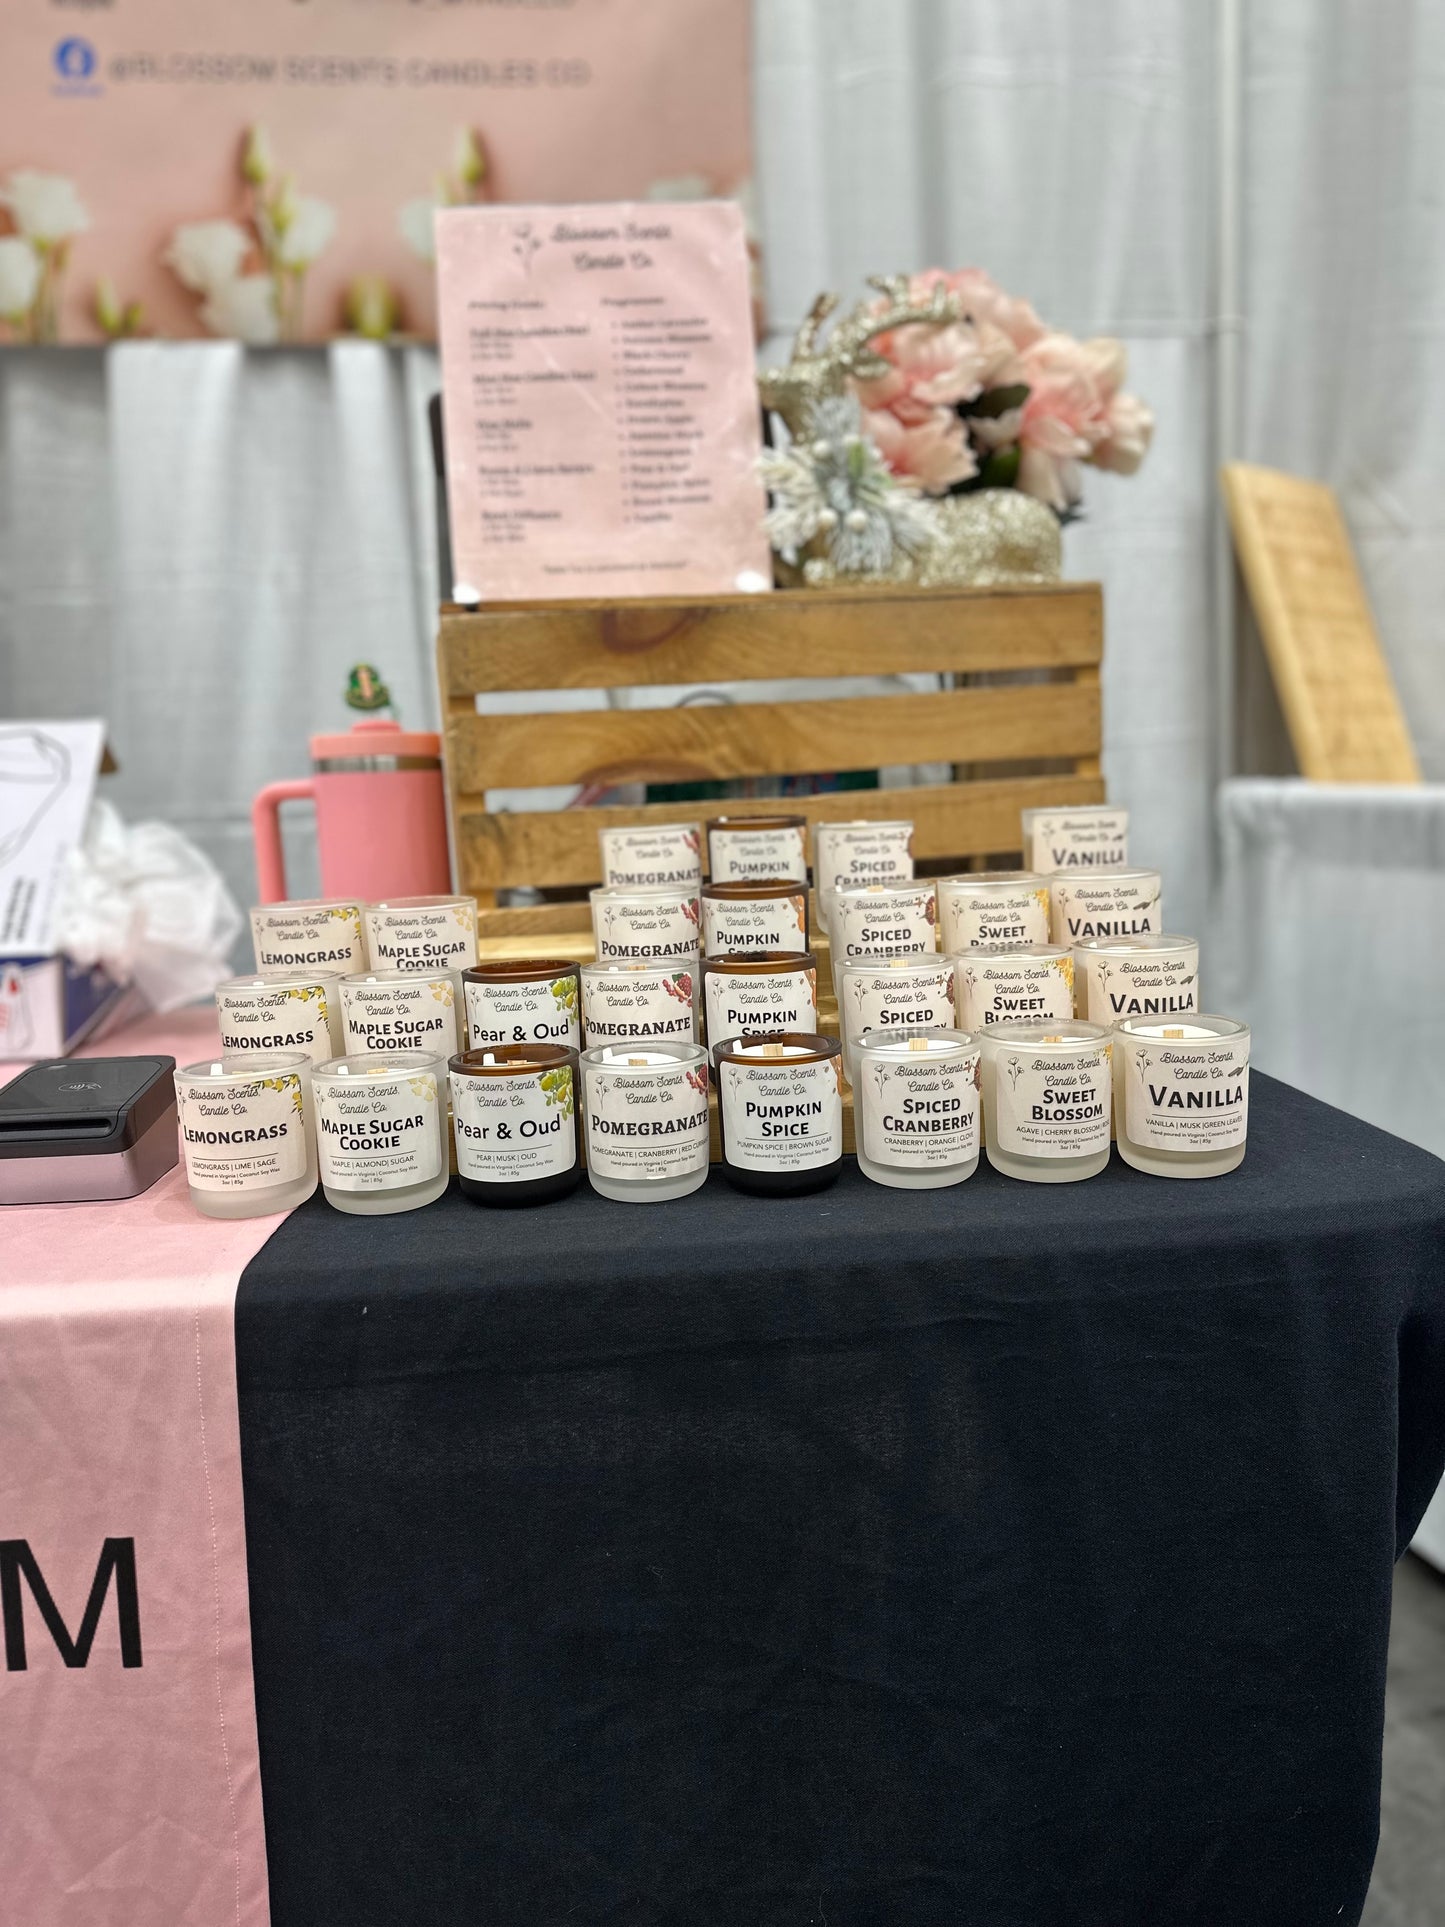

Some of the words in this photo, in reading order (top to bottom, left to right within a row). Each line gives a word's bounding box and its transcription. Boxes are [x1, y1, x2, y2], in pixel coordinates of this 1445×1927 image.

[1052, 848, 1124, 866] VANILLA
[730, 861, 789, 873] PUMPKIN
[850, 860, 896, 873] SPICED
[979, 926, 1026, 938] SWEET
[1068, 918, 1151, 937] VANILLA
[717, 931, 780, 945] PUMPKIN
[862, 929, 912, 941] SPICED
[378, 945, 419, 958] MAPLE
[423, 941, 466, 956] SUGAR
[261, 947, 352, 965] LEMONGRASS
[1120, 963, 1160, 973] Blossom
[983, 970, 1021, 979] Blossom
[597, 982, 630, 992] Blossom
[728, 980, 765, 989] Blossom
[872, 980, 910, 990] Blossom
[1132, 977, 1162, 987] Candle
[483, 988, 519, 998] Blossom
[995, 984, 1024, 994] Candle
[355, 991, 391, 1001] Blossom
[606, 996, 633, 1006] Candle
[739, 994, 768, 1004] Candle
[884, 994, 913, 1004] Candle
[224, 998, 255, 1008] Blossom
[494, 1002, 522, 1012] Candle
[994, 997, 1045, 1010] SWEET
[1110, 993, 1193, 1013] VANILLA
[366, 1005, 394, 1016] Candle
[233, 1012, 259, 1022] Candle
[728, 1010, 797, 1024] PUMPKIN
[880, 1010, 933, 1024] SPICED
[349, 1020, 391, 1035] MAPLE
[394, 1018, 443, 1034] SUGAR
[474, 1024, 506, 1041] Pear
[513, 1026, 527, 1041] &
[534, 1018, 569, 1039] Oud
[586, 1017, 691, 1036] POMEGRANATE
[222, 1031, 313, 1049] LEMONGRASS
[367, 1036, 422, 1049] COOKIE
[1160, 1053, 1205, 1063] Blossom
[1032, 1060, 1075, 1070] Blossom
[746, 1070, 787, 1080] Blossom
[895, 1066, 937, 1076] Blossom
[1174, 1068, 1208, 1079] Candle
[466, 1081, 504, 1091] Blossom
[613, 1078, 654, 1088] Blossom
[1045, 1075, 1077, 1086] Candle
[759, 1085, 790, 1096] Candle
[908, 1081, 939, 1092] Candle
[188, 1089, 225, 1100] Blossom
[328, 1087, 365, 1098] Blossom
[1043, 1088, 1096, 1104] SWEET
[1149, 1084, 1243, 1108] VANILLA
[477, 1096, 507, 1107] Candle
[626, 1093, 657, 1104] Candle
[199, 1105, 229, 1116] Candle
[338, 1103, 369, 1114] Candle
[746, 1101, 821, 1118] PUMPKIN
[903, 1098, 960, 1114] SPICED
[1032, 1104, 1103, 1121] BLOSSOM
[321, 1118, 365, 1135] MAPLE
[370, 1115, 424, 1134] SUGAR
[457, 1118, 489, 1139] Pear
[497, 1123, 512, 1139] &
[520, 1113, 560, 1137] Oud
[592, 1109, 708, 1136] POMEGRANATE
[883, 1112, 974, 1132] CRANBERRY
[1146, 1118, 1174, 1128] VANILLA
[184, 1123, 288, 1144] LEMONGRASS
[762, 1122, 809, 1137] SPICE
[1017, 1126, 1039, 1134] AGAVE
[1074, 1125, 1100, 1134] BLOSSOM
[340, 1136, 400, 1150] COOKIE
[737, 1141, 762, 1150] PUMPKIN
[789, 1141, 814, 1149] BROWN
[815, 1136, 832, 1146] SUGAR
[884, 1138, 924, 1146] CRANBERRY
[929, 1137, 956, 1146] ORANGE
[592, 1145, 633, 1158] POMEGRANATE
[638, 1148, 677, 1158] CRANBERRY
[192, 1162, 230, 1171] LEMONGRASS
[257, 1158, 276, 1167] SAGE
[391, 1156, 414, 1165] SUGAR
[0, 1537, 142, 1671] M
